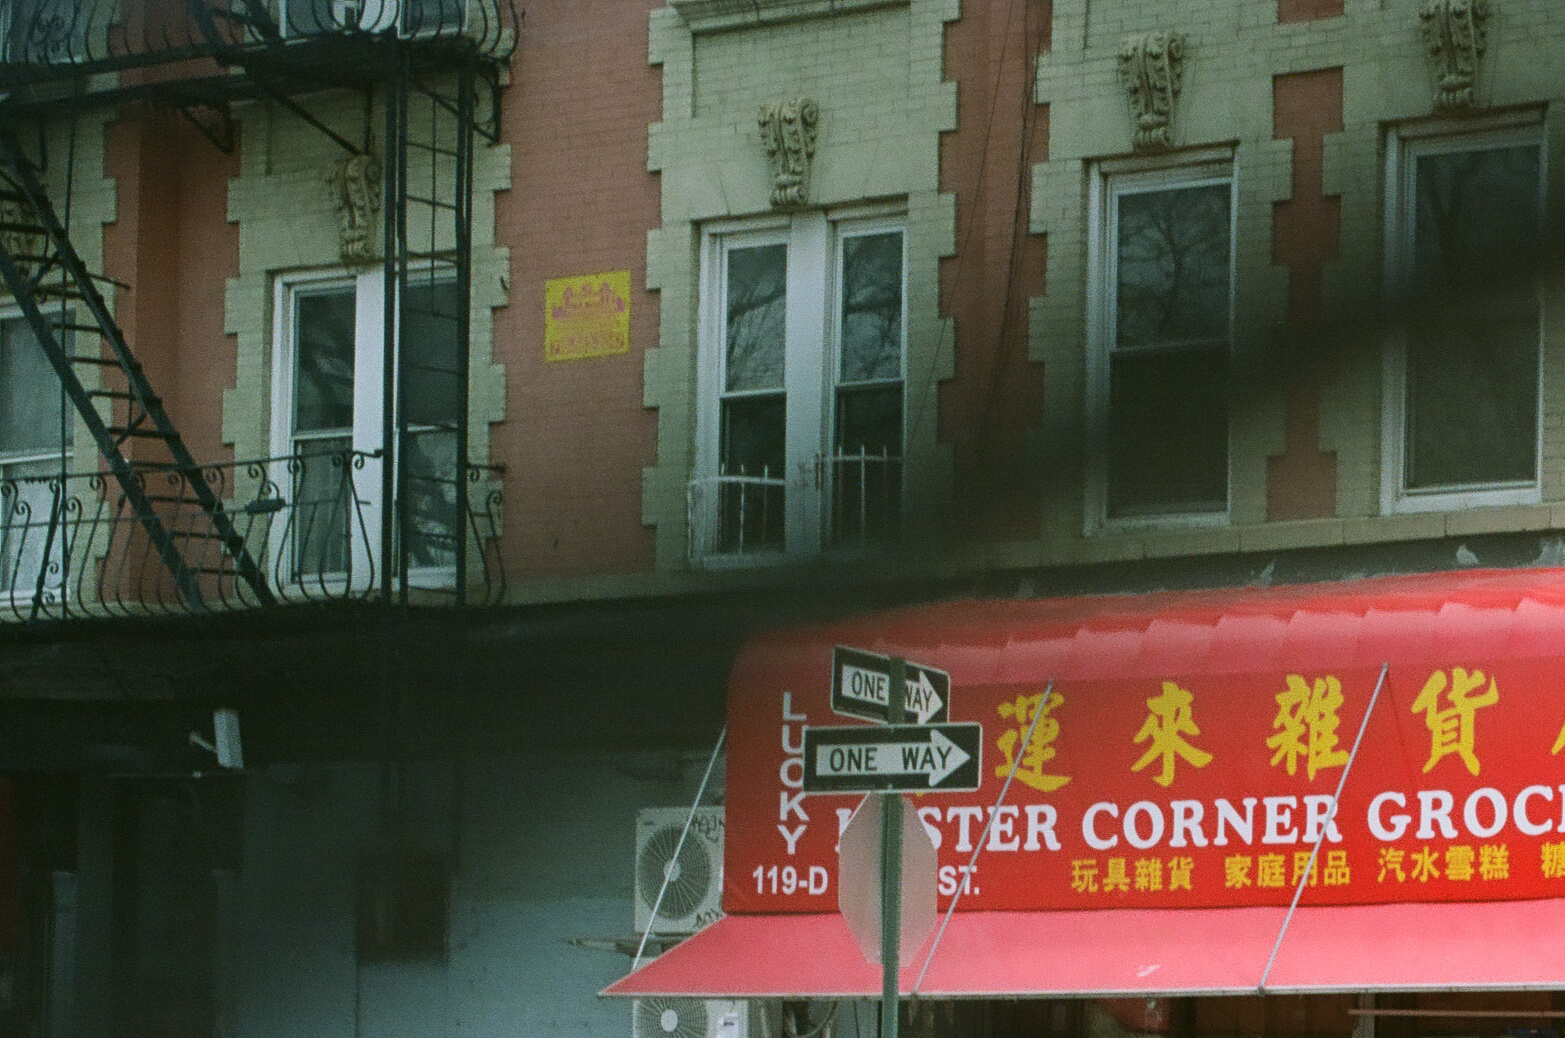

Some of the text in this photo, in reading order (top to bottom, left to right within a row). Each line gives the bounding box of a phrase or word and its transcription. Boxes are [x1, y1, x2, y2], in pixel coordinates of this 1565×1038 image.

[851, 670, 886, 701] ONE
[829, 745, 953, 772] ONE WAY
[836, 804, 1062, 854] STER
[1082, 793, 1343, 850] CORNER
[752, 865, 980, 896] 119-D ST.
[1071, 854, 1195, 893] 玩具雜貨
[1224, 850, 1351, 888] 家庭用品
